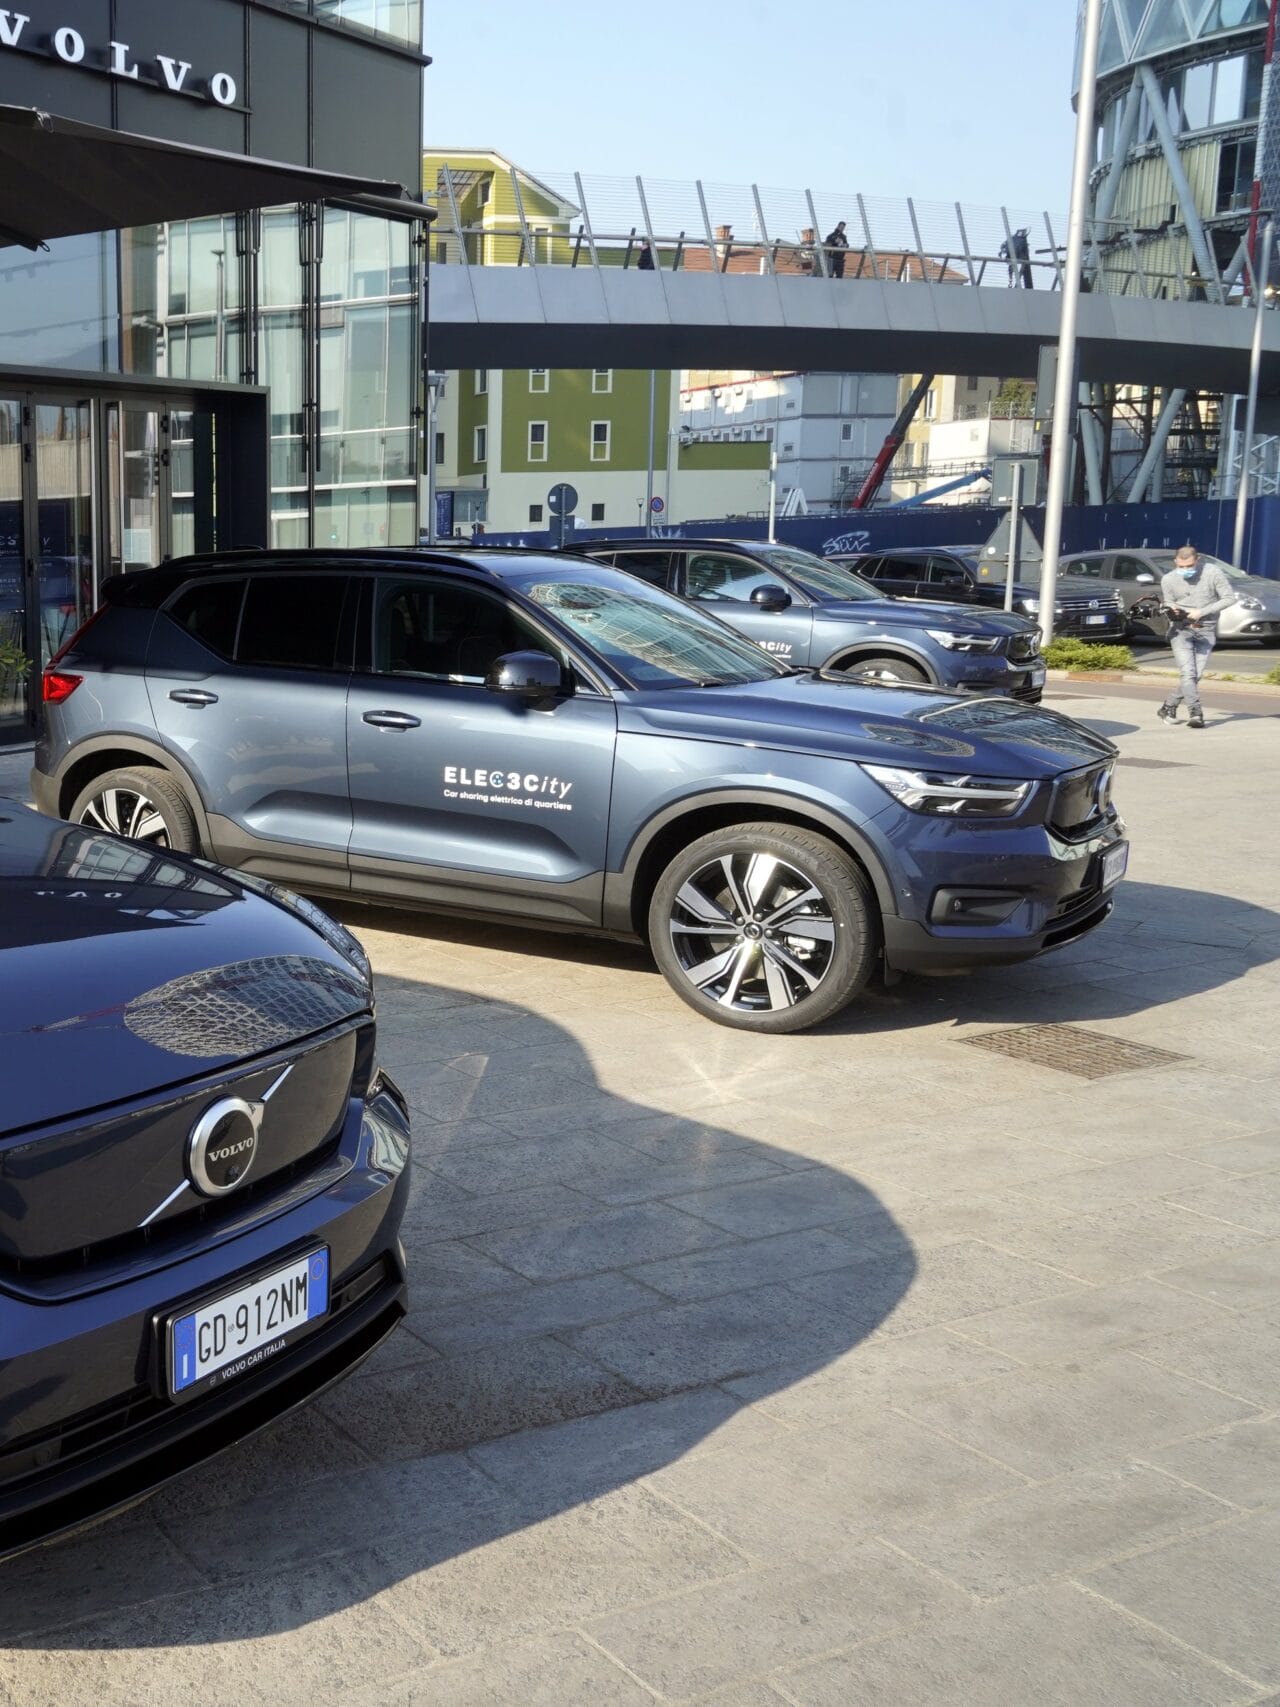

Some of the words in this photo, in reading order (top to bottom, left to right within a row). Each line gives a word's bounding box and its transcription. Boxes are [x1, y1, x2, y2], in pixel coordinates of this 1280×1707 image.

[444, 766, 573, 799] ELEC3City
[444, 789, 458, 798] Car
[459, 791, 489, 803] sharing
[490, 793, 523, 805] elettrico
[524, 798, 533, 806] di
[534, 800, 573, 811] quartiere
[207, 1137, 254, 1162] VOLVO
[221, 1360, 247, 1379] VOLVO
[247, 1351, 263, 1366] CAR
[264, 1339, 286, 1357] ITALIA
